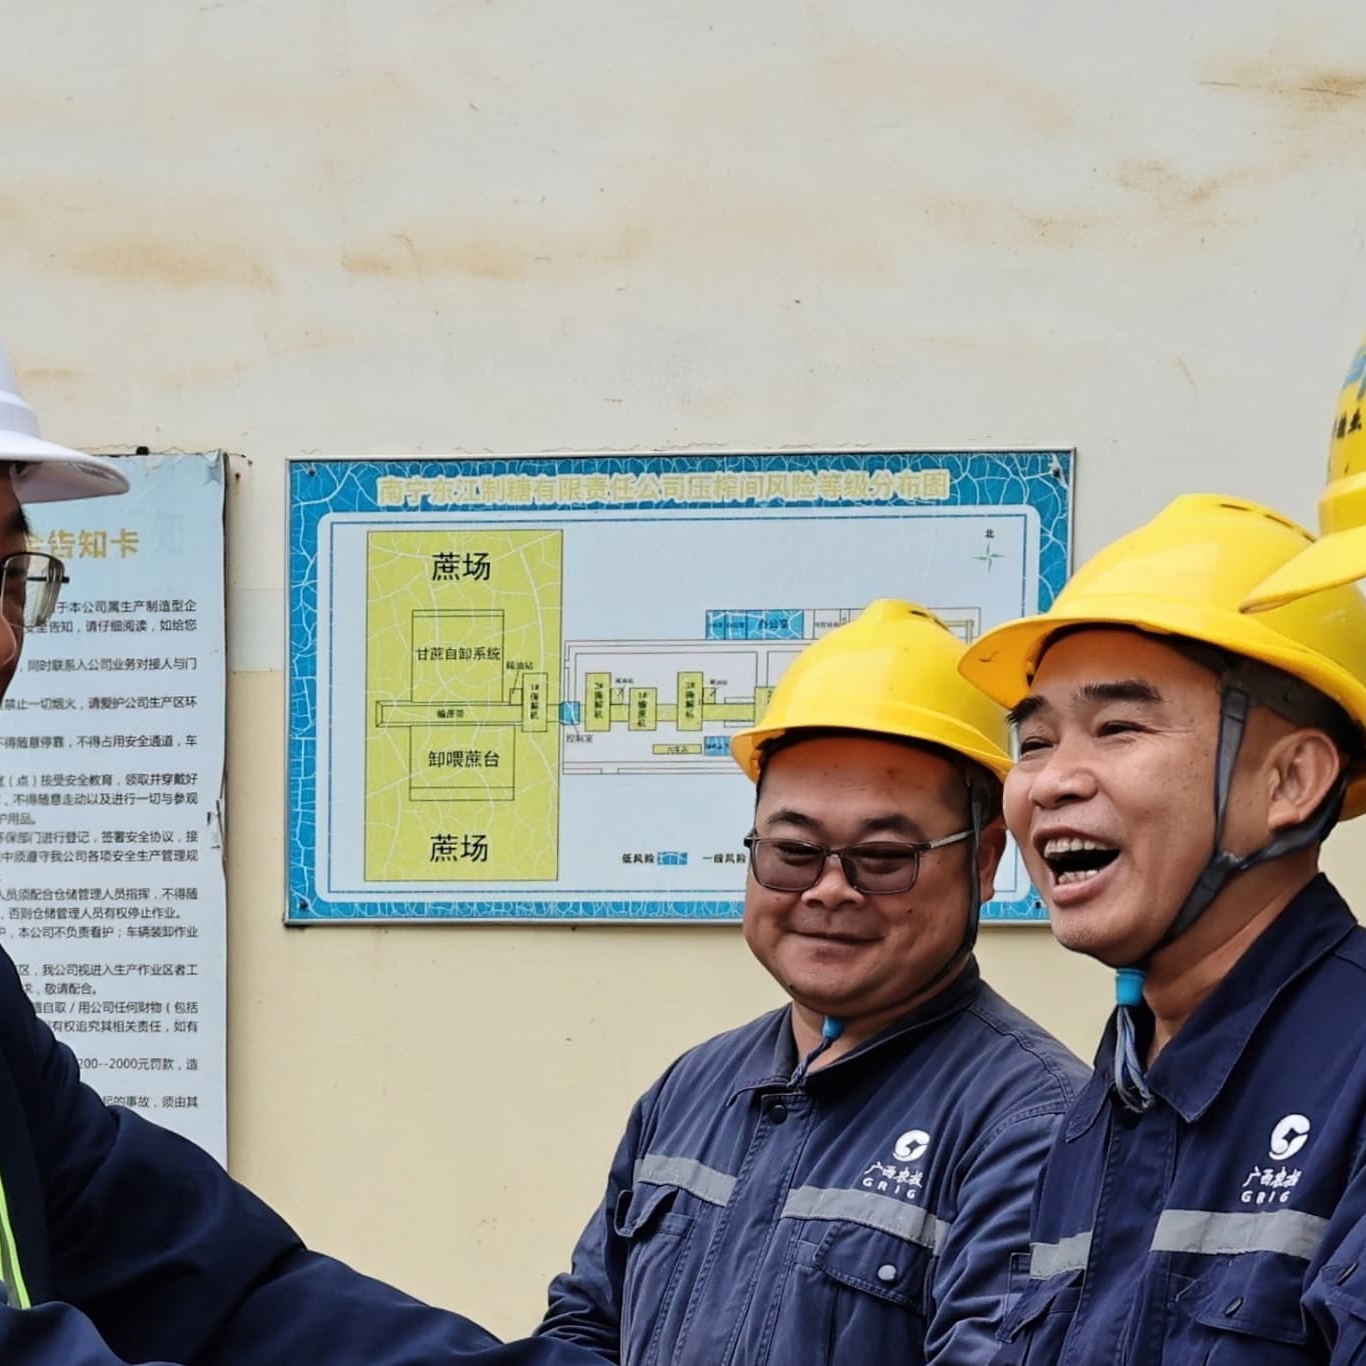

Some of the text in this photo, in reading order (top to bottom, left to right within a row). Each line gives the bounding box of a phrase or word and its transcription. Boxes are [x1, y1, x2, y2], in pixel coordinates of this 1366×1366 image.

[431, 552, 491, 582] 蔗场
[415, 646, 501, 662] 甘蔗自卸系统
[427, 750, 501, 769] 卸喂蔗台
[429, 833, 489, 863] 蔗场
[863, 1177, 917, 1199] GRIG
[1241, 1190, 1291, 1204] GRIG
